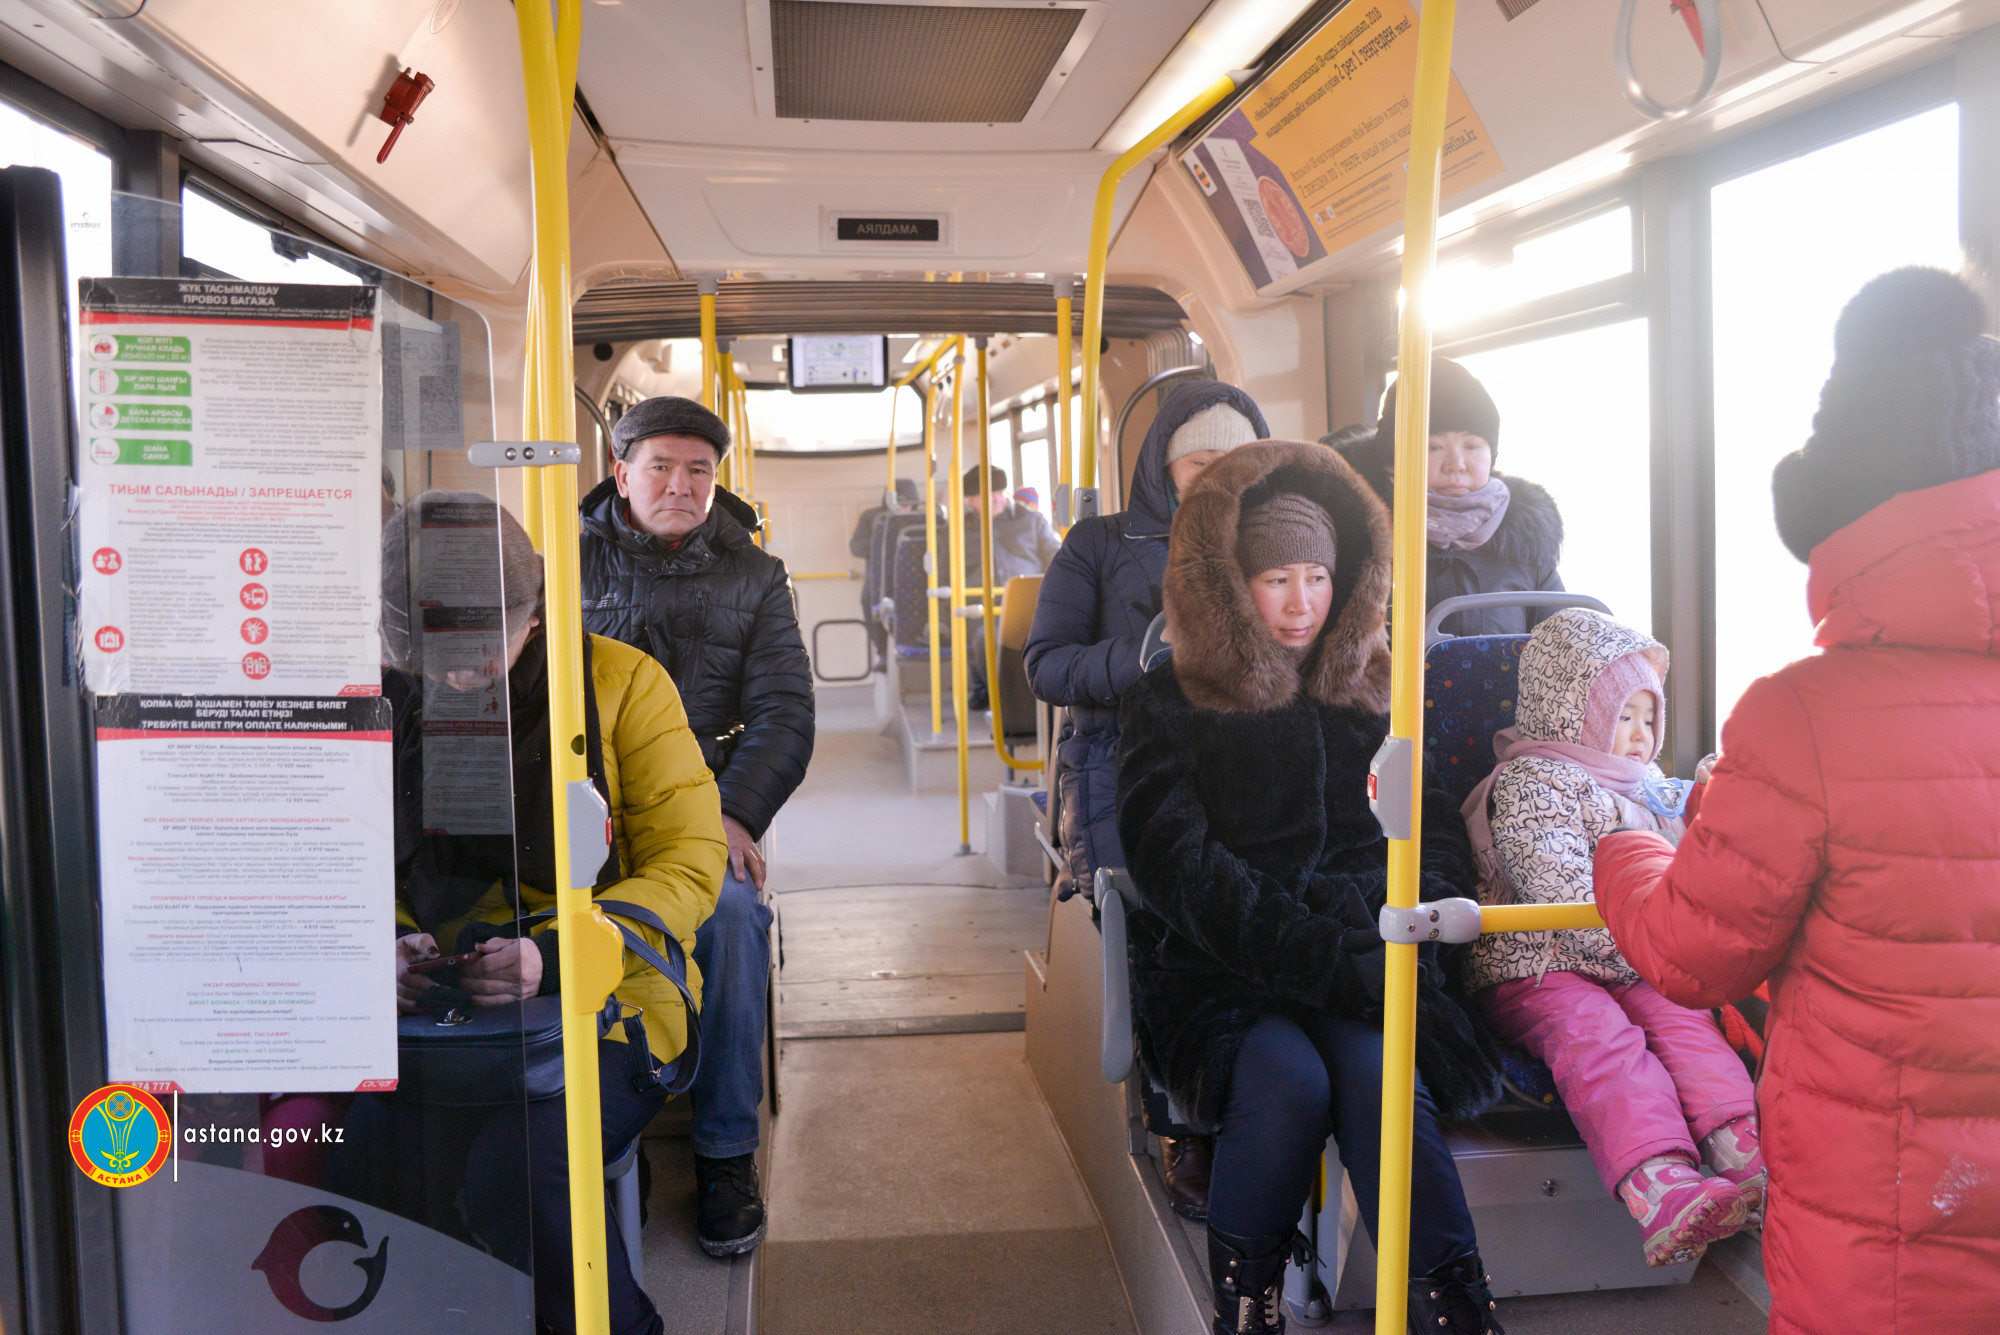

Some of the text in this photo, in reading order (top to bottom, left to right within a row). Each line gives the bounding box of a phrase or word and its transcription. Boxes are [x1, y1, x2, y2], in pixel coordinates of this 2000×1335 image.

[1366, 7, 1382, 25] 2018
[1334, 64, 1345, 80] 2
[1341, 57, 1357, 80] рет
[1359, 25, 1397, 62] теңгеден
[856, 223, 918, 235] АЯЛДАМА
[179, 284, 280, 296] ЖҮК ТАСЫМАЛДАУ
[183, 294, 276, 306] ПРОВОЗ БАГАЖА
[108, 484, 151, 495] ТИЫМ
[155, 484, 238, 498] САЛЫНАДЫ
[249, 487, 352, 500] ЗАПРЕЩАЕТСЯ
[140, 700, 348, 710] ҚОЛМА ҚОЛ АҚШАМЕН ТӨЛЕУ КЕЗІНДЕ БИЛЕТ
[196, 709, 293, 719] БЕРУДІ ТАЛАП ЕТІҢІЗ!
[141, 719, 347, 730] ТРЕБУЙТЕ БИЛЕТ ПРИ ОПЛАТЕ НАЛИЧНЫМИ!
[153, 1082, 171, 1091] 777
